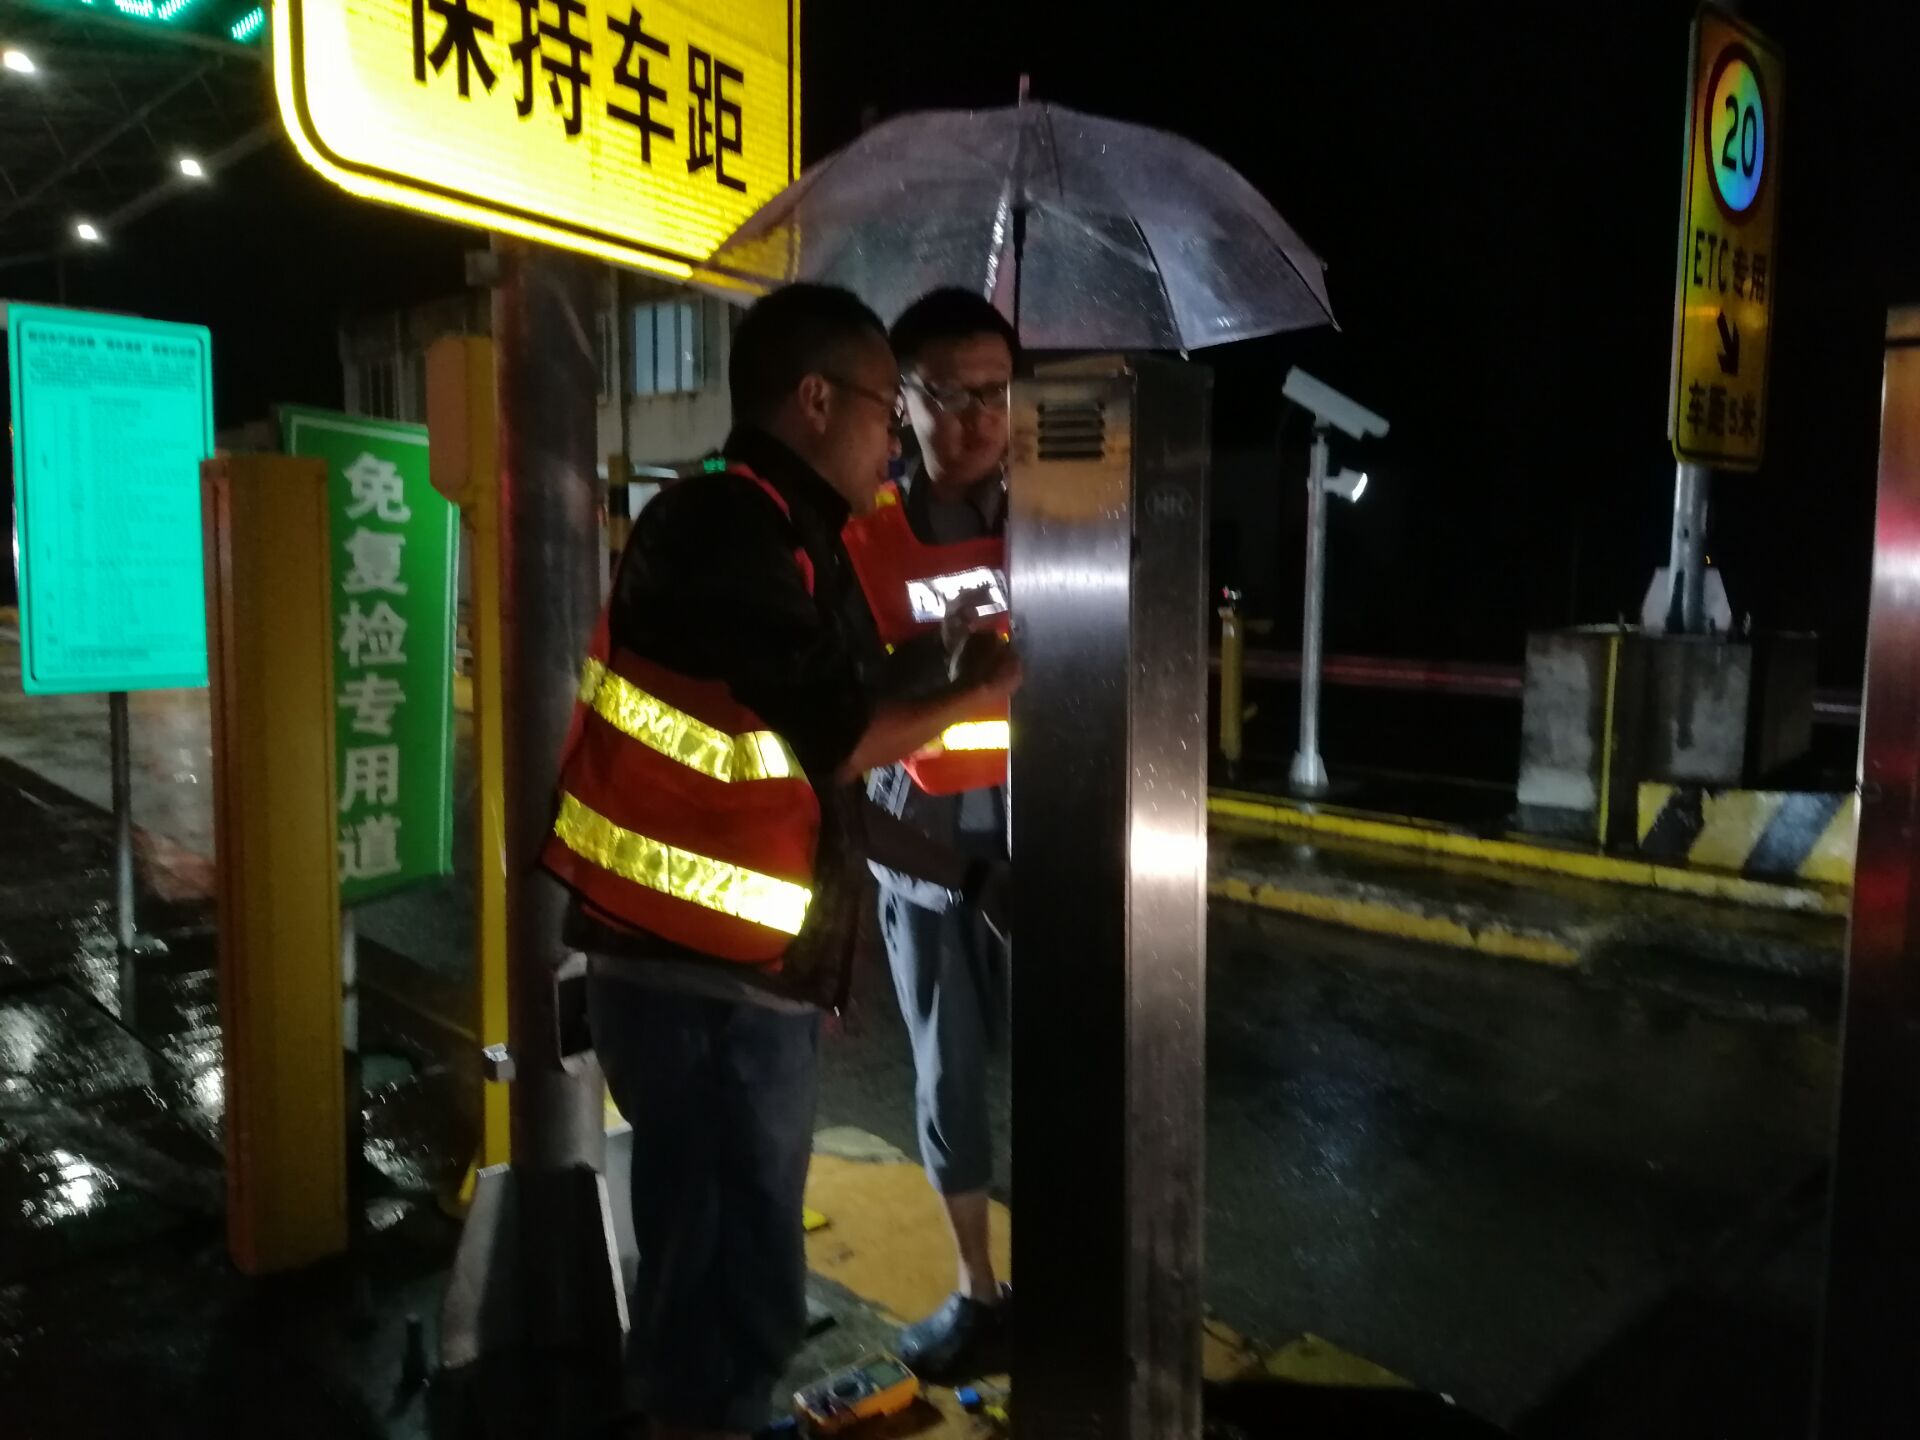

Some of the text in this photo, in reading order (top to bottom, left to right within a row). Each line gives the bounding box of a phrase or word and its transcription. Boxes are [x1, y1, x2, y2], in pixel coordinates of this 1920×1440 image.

[1721, 94, 1758, 178] 20
[338, 451, 411, 885] 免复检专用道
